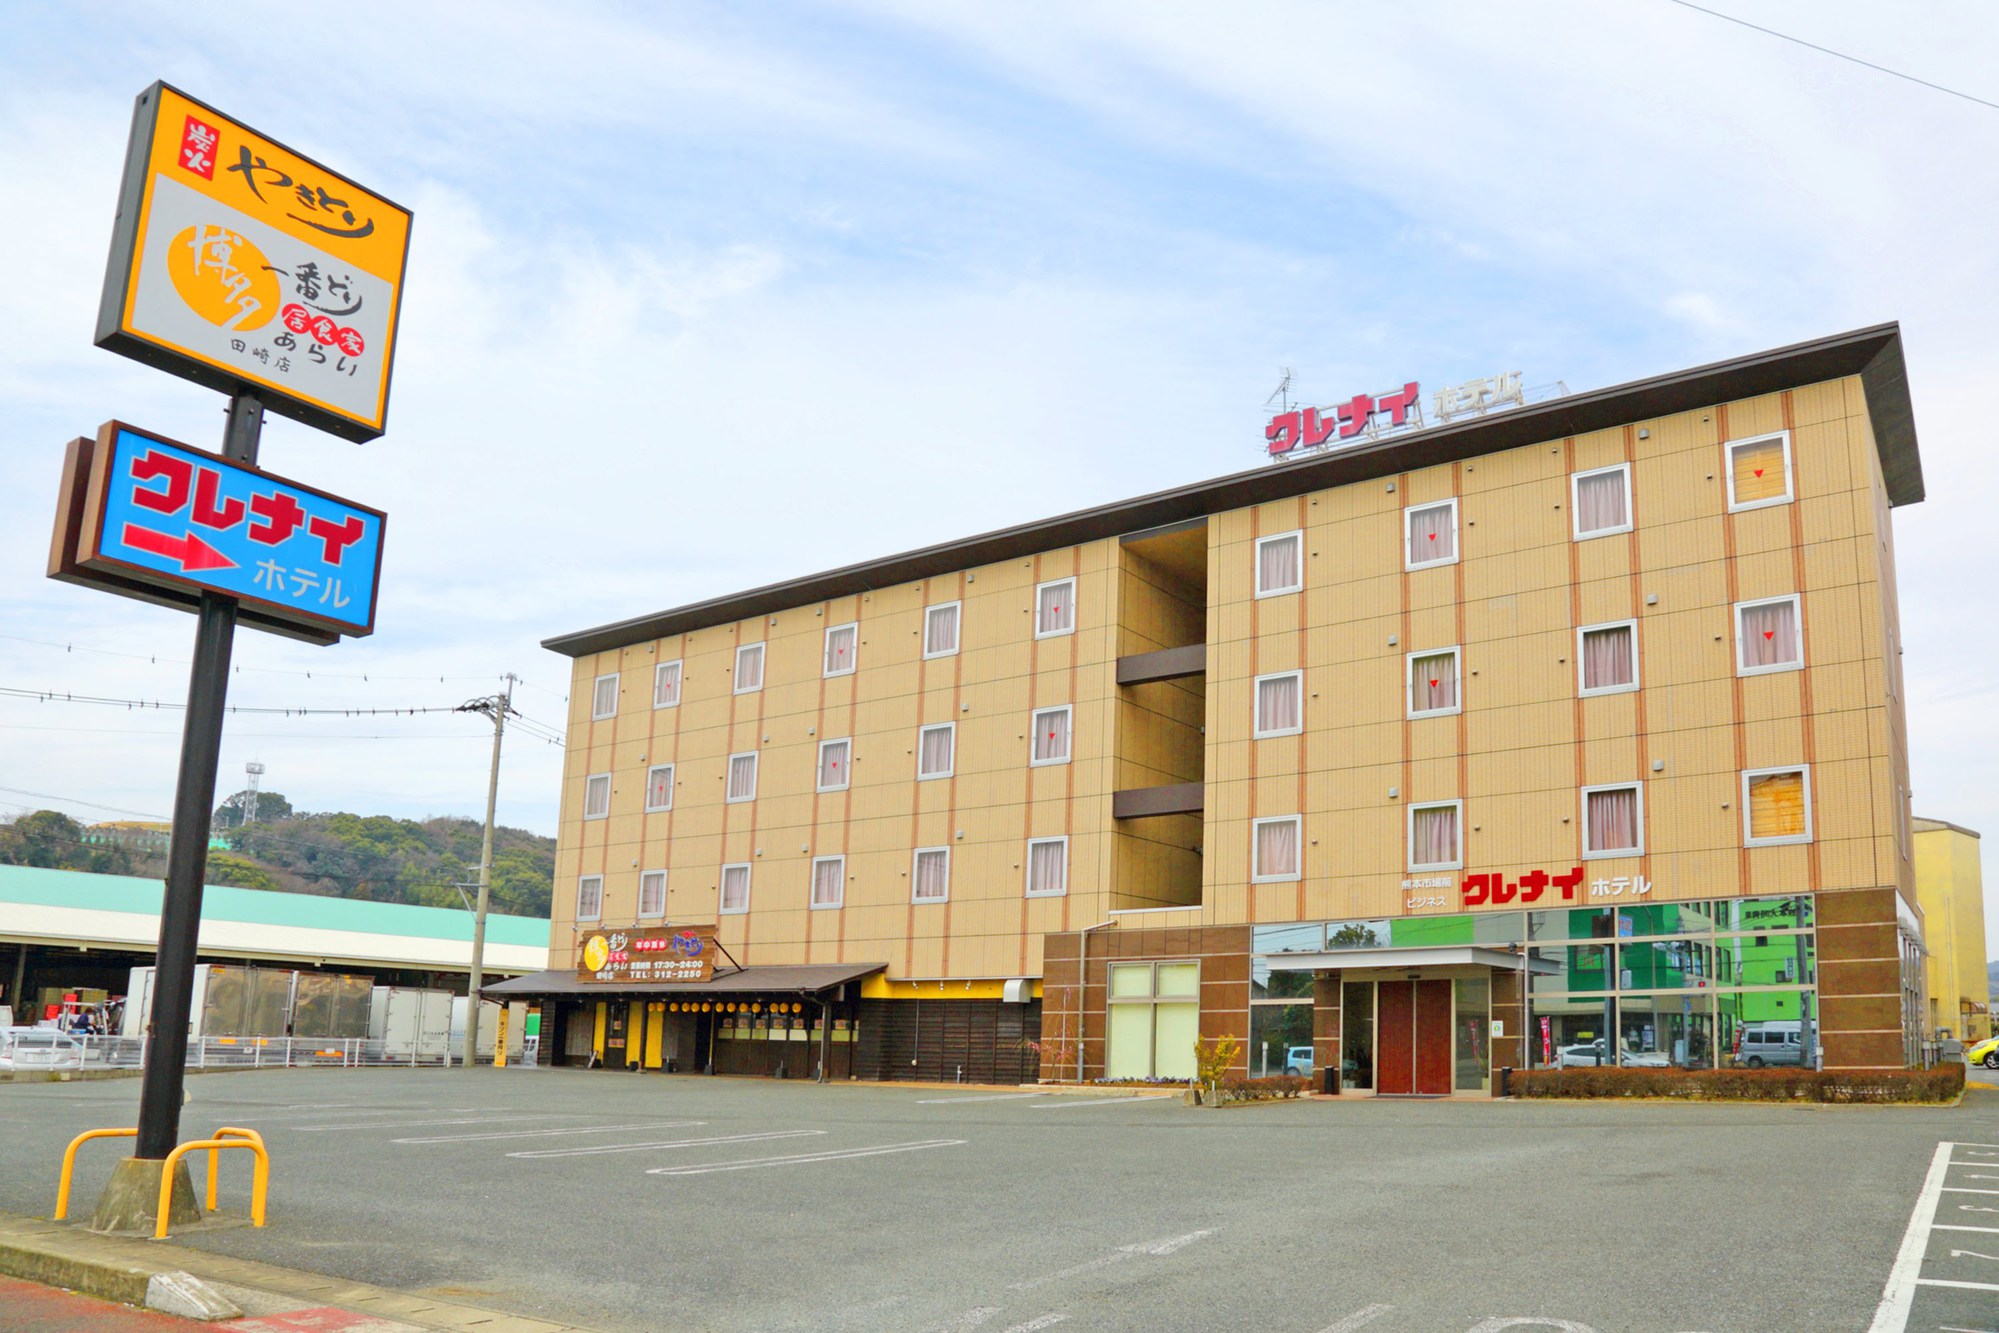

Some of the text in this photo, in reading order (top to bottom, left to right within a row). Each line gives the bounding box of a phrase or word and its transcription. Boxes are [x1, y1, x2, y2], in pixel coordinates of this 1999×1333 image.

[185, 123, 215, 173] 炭火
[227, 145, 374, 238] やきとり
[187, 225, 262, 331] 博多
[261, 262, 362, 315] 一番どり
[231, 338, 291, 373] 田崎店
[274, 331, 357, 376] あらい
[1266, 373, 1521, 455] クレナイ ホテル
[129, 448, 365, 567] クレナイ
[253, 559, 350, 608] ホテル
[1401, 877, 1452, 891] 熊本市場前
[1406, 895, 1447, 909] ビジネス
[1461, 867, 1652, 906] クレナイ ホテル
[654, 970, 701, 978] 312-2250
